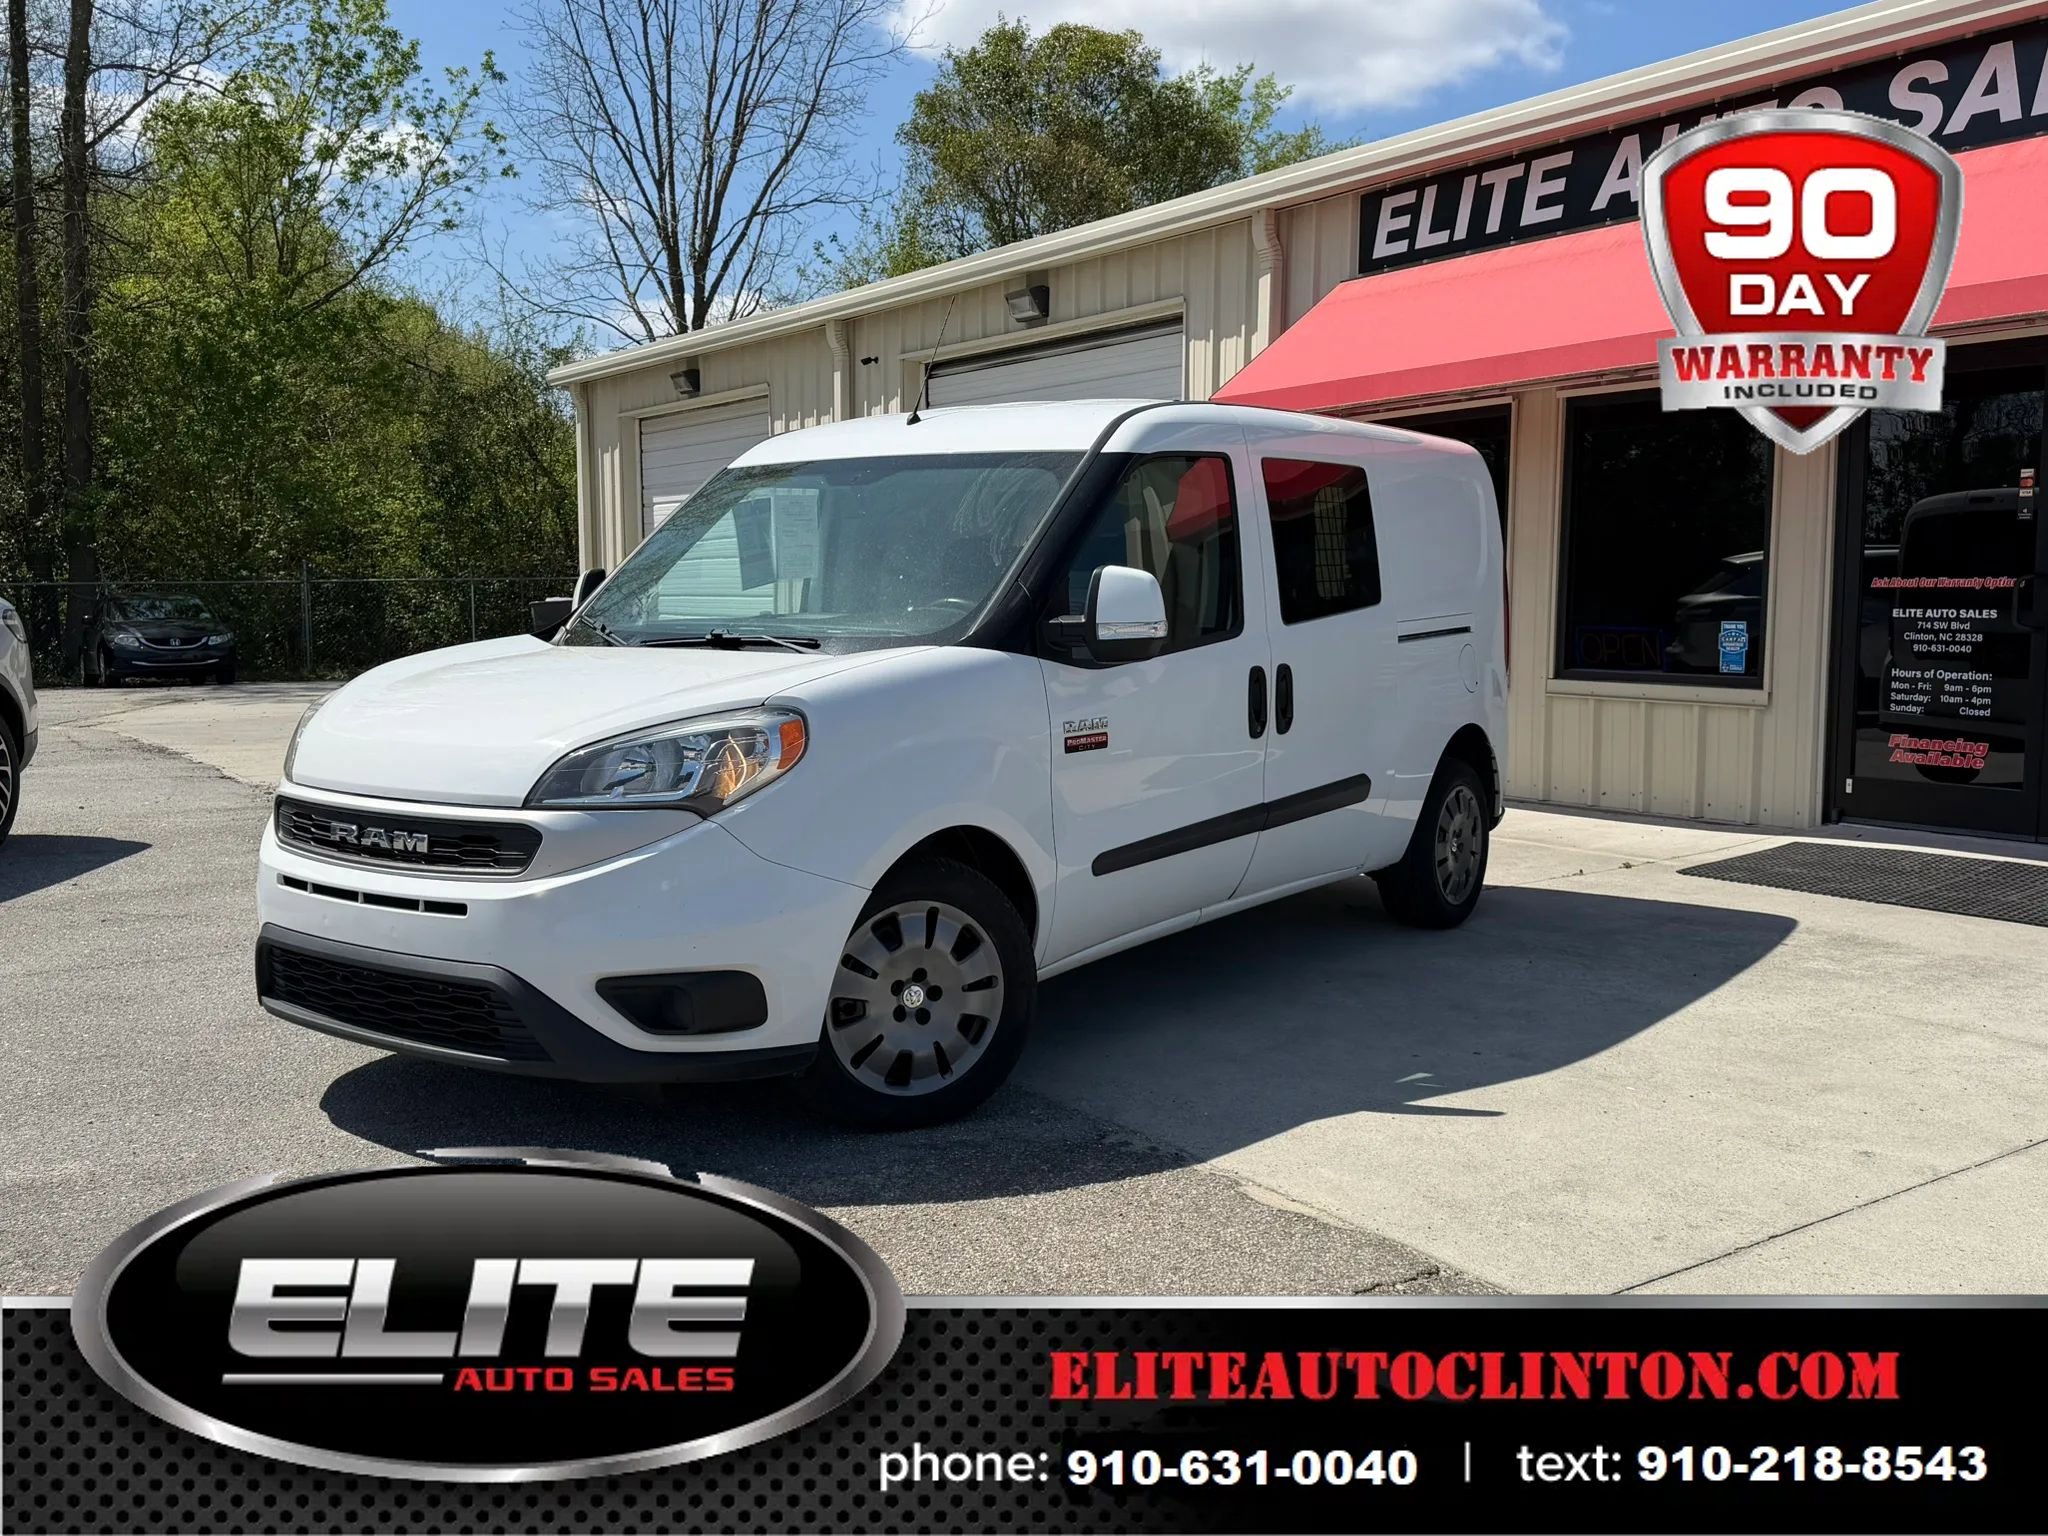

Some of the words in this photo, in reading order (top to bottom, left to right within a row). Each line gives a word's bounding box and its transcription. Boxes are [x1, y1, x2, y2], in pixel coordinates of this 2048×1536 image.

[1372, 150, 1574, 260] ELITE
[1889, 40, 2048, 137] SA
[1871, 577, 1890, 588] Ask
[1890, 577, 1919, 588] About
[1919, 577, 1938, 588] Our
[1937, 577, 1984, 590] Warranty
[1892, 608, 1924, 618] ELITE
[1925, 609, 1957, 618] AUTO
[1959, 609, 1998, 619] SALES
[1917, 621, 1931, 629] 714
[1933, 621, 1949, 630] SW
[1950, 621, 1971, 630] Blvd
[1904, 632, 1937, 642] Clinton,
[1939, 633, 1953, 641] NC
[1955, 633, 1983, 642] 28328
[1581, 633, 1661, 666] OPEN
[1913, 644, 1972, 653] 910-631-0040
[1891, 668, 1921, 678] Hours
[1924, 669, 1935, 679] of
[1936, 669, 1993, 681] Operation:
[1891, 681, 1910, 690] Mon
[1917, 682, 1932, 691] Fri:
[1944, 684, 1963, 692] 9am
[1971, 684, 1992, 694] 6pm
[1890, 692, 1932, 703] Saturday:
[1940, 695, 1963, 703] 10am
[1971, 696, 1991, 706] 4pm
[1889, 703, 1925, 714] Sunday:
[1959, 707, 1991, 716] Closed
[1063, 716, 1109, 734] RAM
[1888, 733, 1989, 757] Financing
[1889, 749, 1985, 769] Available
[330, 821, 428, 853] RAM
